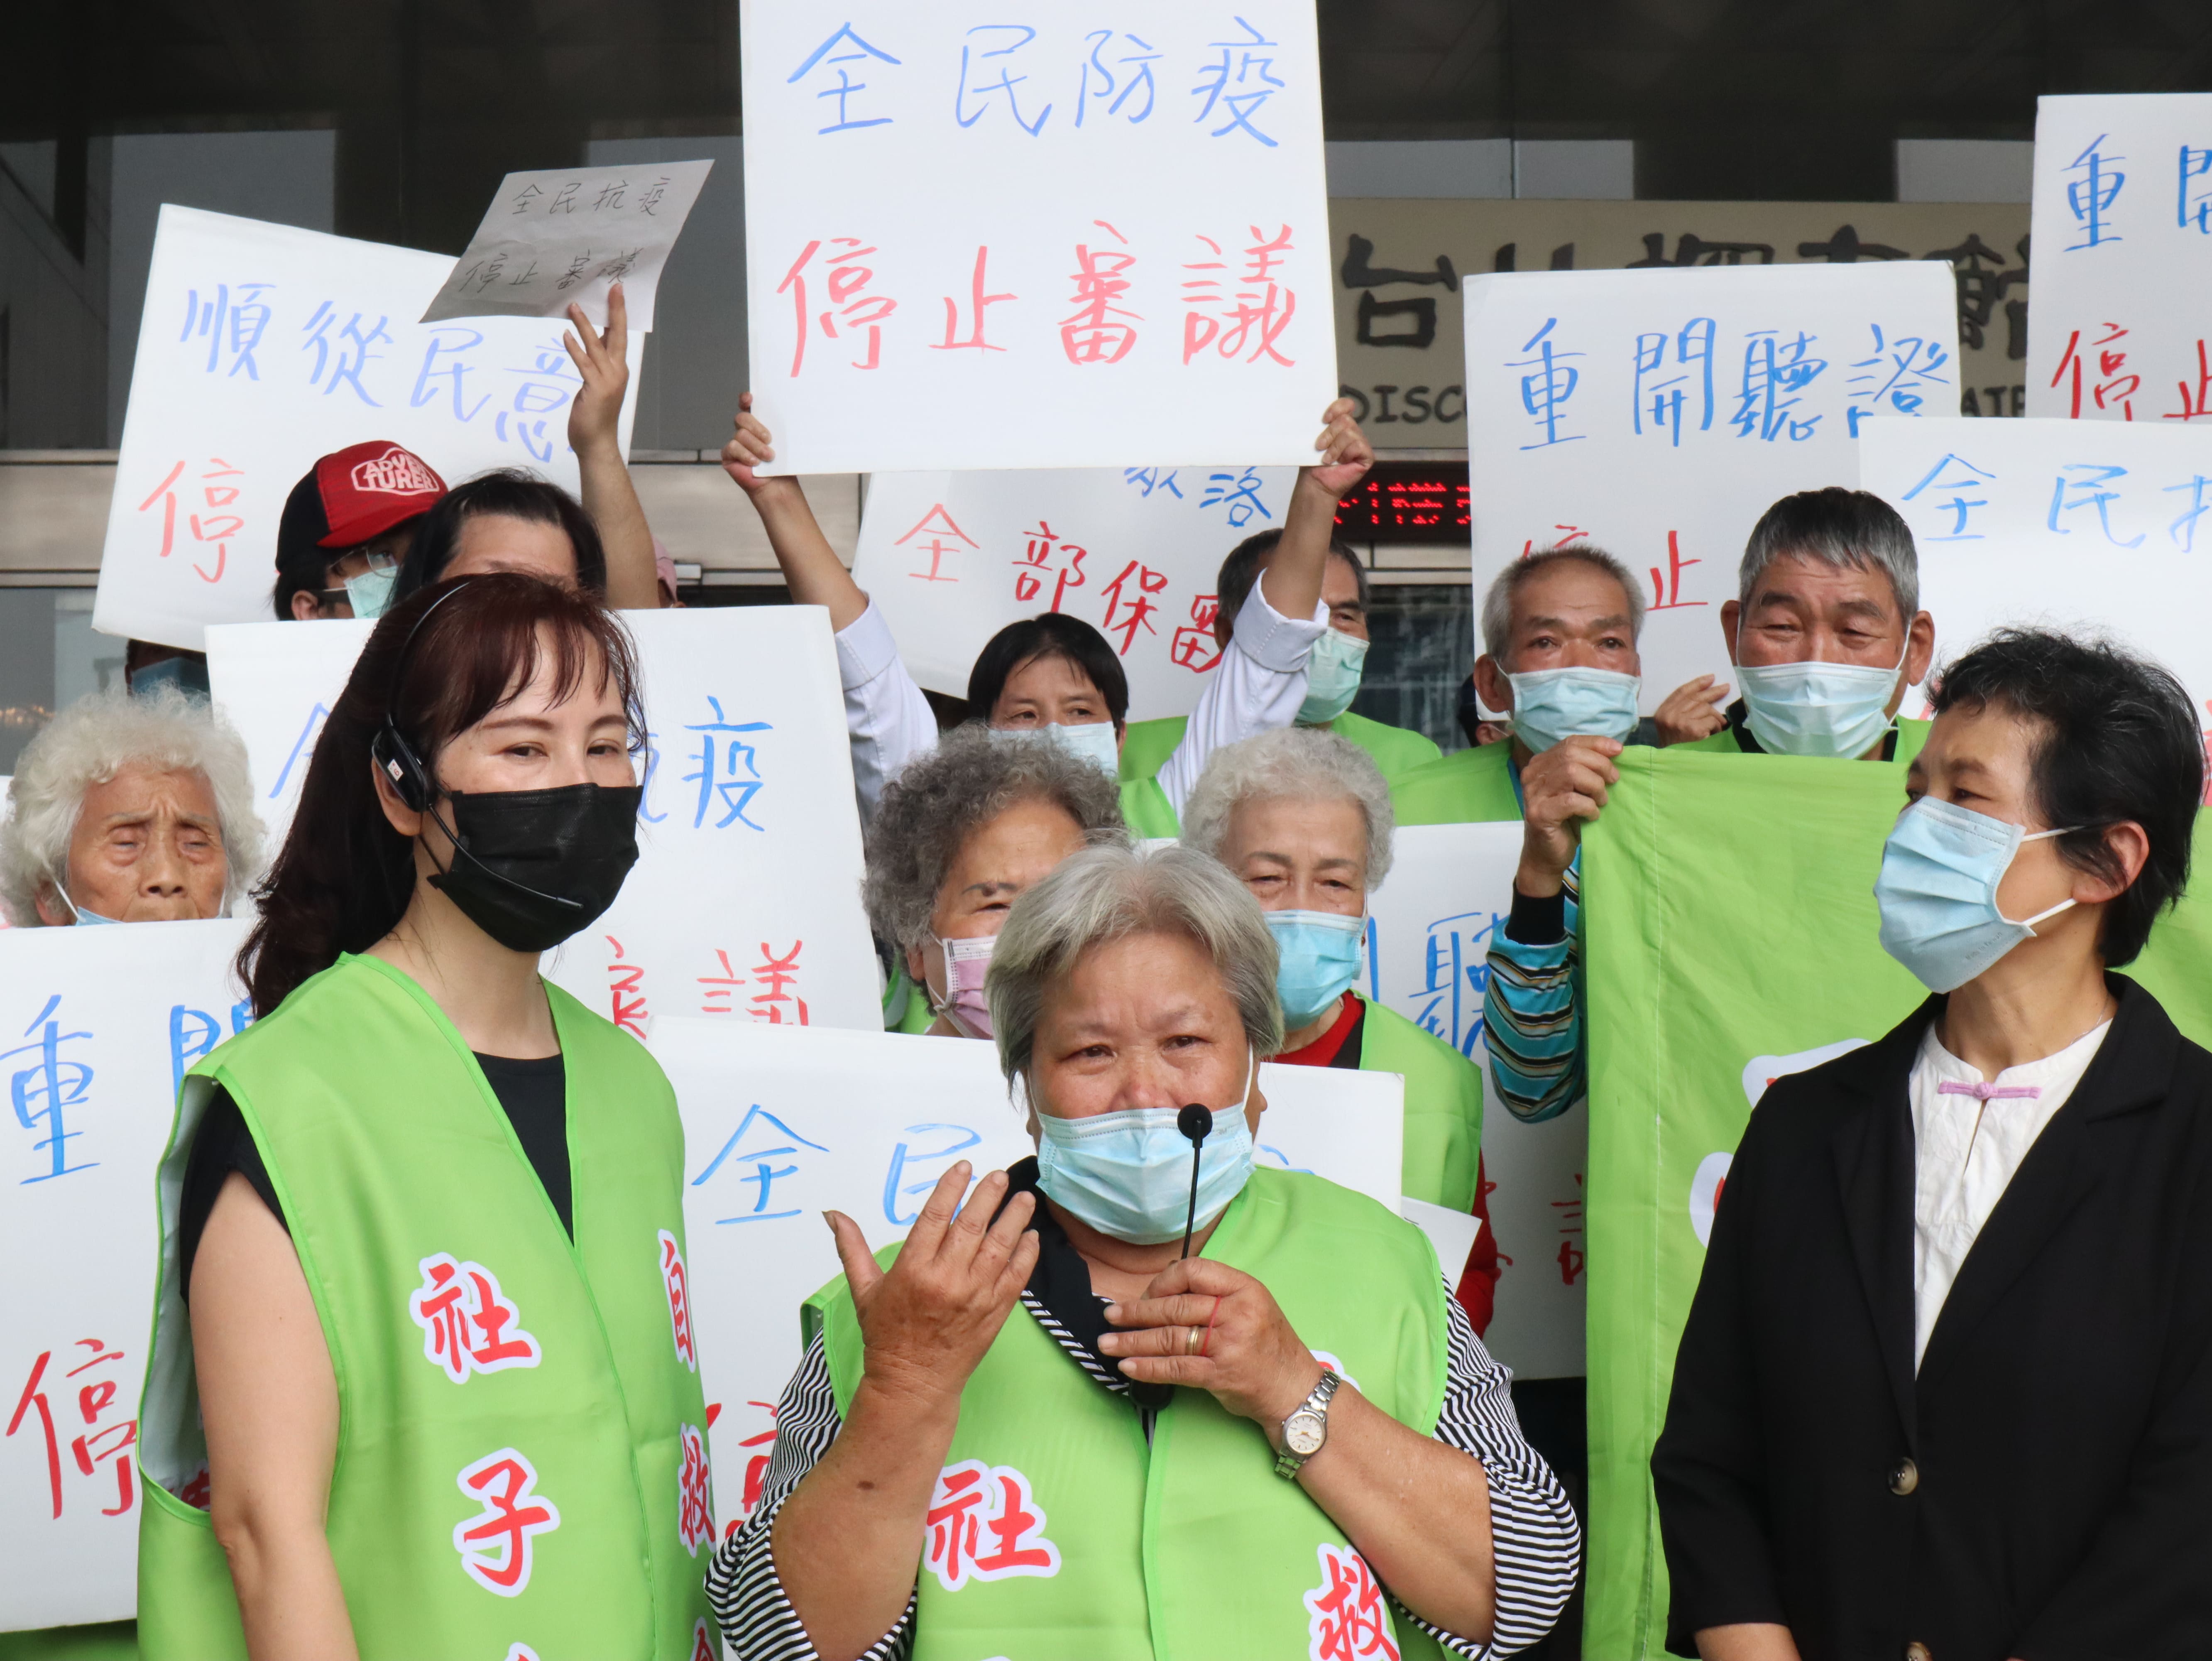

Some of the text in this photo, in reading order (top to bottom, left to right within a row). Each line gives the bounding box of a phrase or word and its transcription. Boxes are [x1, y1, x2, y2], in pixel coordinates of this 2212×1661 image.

[787, 16, 1285, 148] 全民防疫
[512, 178, 670, 216] 全民抗疫
[459, 248, 644, 293] 停止審議
[777, 220, 1295, 377] 停止審議
[180, 284, 583, 463] 順從民意
[1505, 317, 1950, 447] 重開聽證
